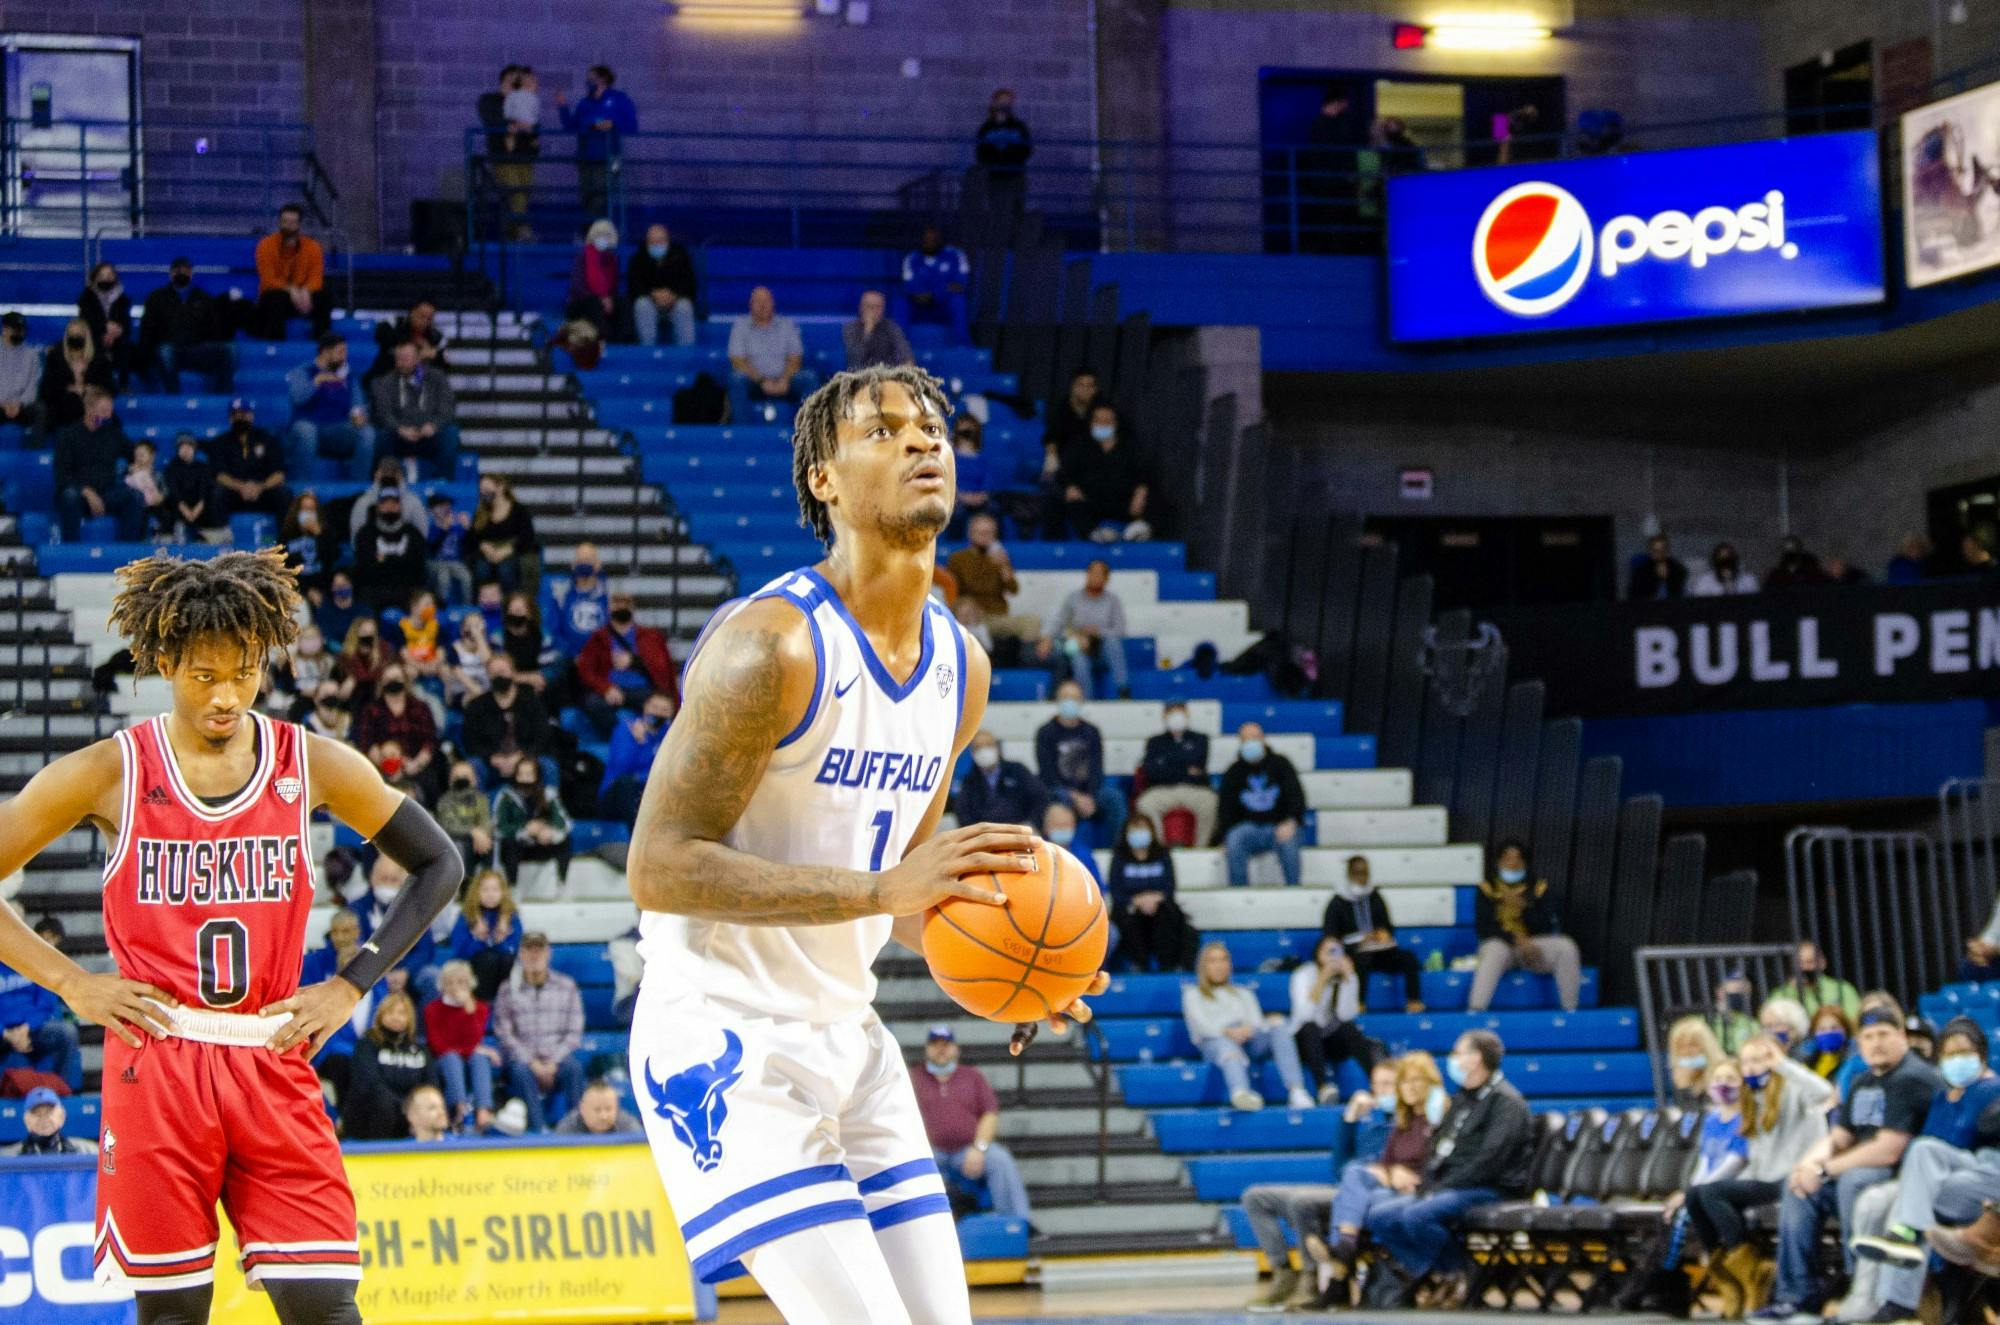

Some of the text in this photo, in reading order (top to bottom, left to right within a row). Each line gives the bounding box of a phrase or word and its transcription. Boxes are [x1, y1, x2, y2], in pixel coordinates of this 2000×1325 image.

[1635, 617, 1839, 688] BULL
[815, 747, 942, 793] BUFFALO
[138, 836, 299, 906] HUSKIES
[867, 810, 893, 872] 1
[197, 917, 249, 1009] 0
[370, 1174, 495, 1200] Steakhouse
[502, 1173, 559, 1195] Since
[359, 1287, 383, 1309] of
[388, 1283, 458, 1311] Maple
[464, 1284, 481, 1303] &
[488, 1279, 553, 1301] North
